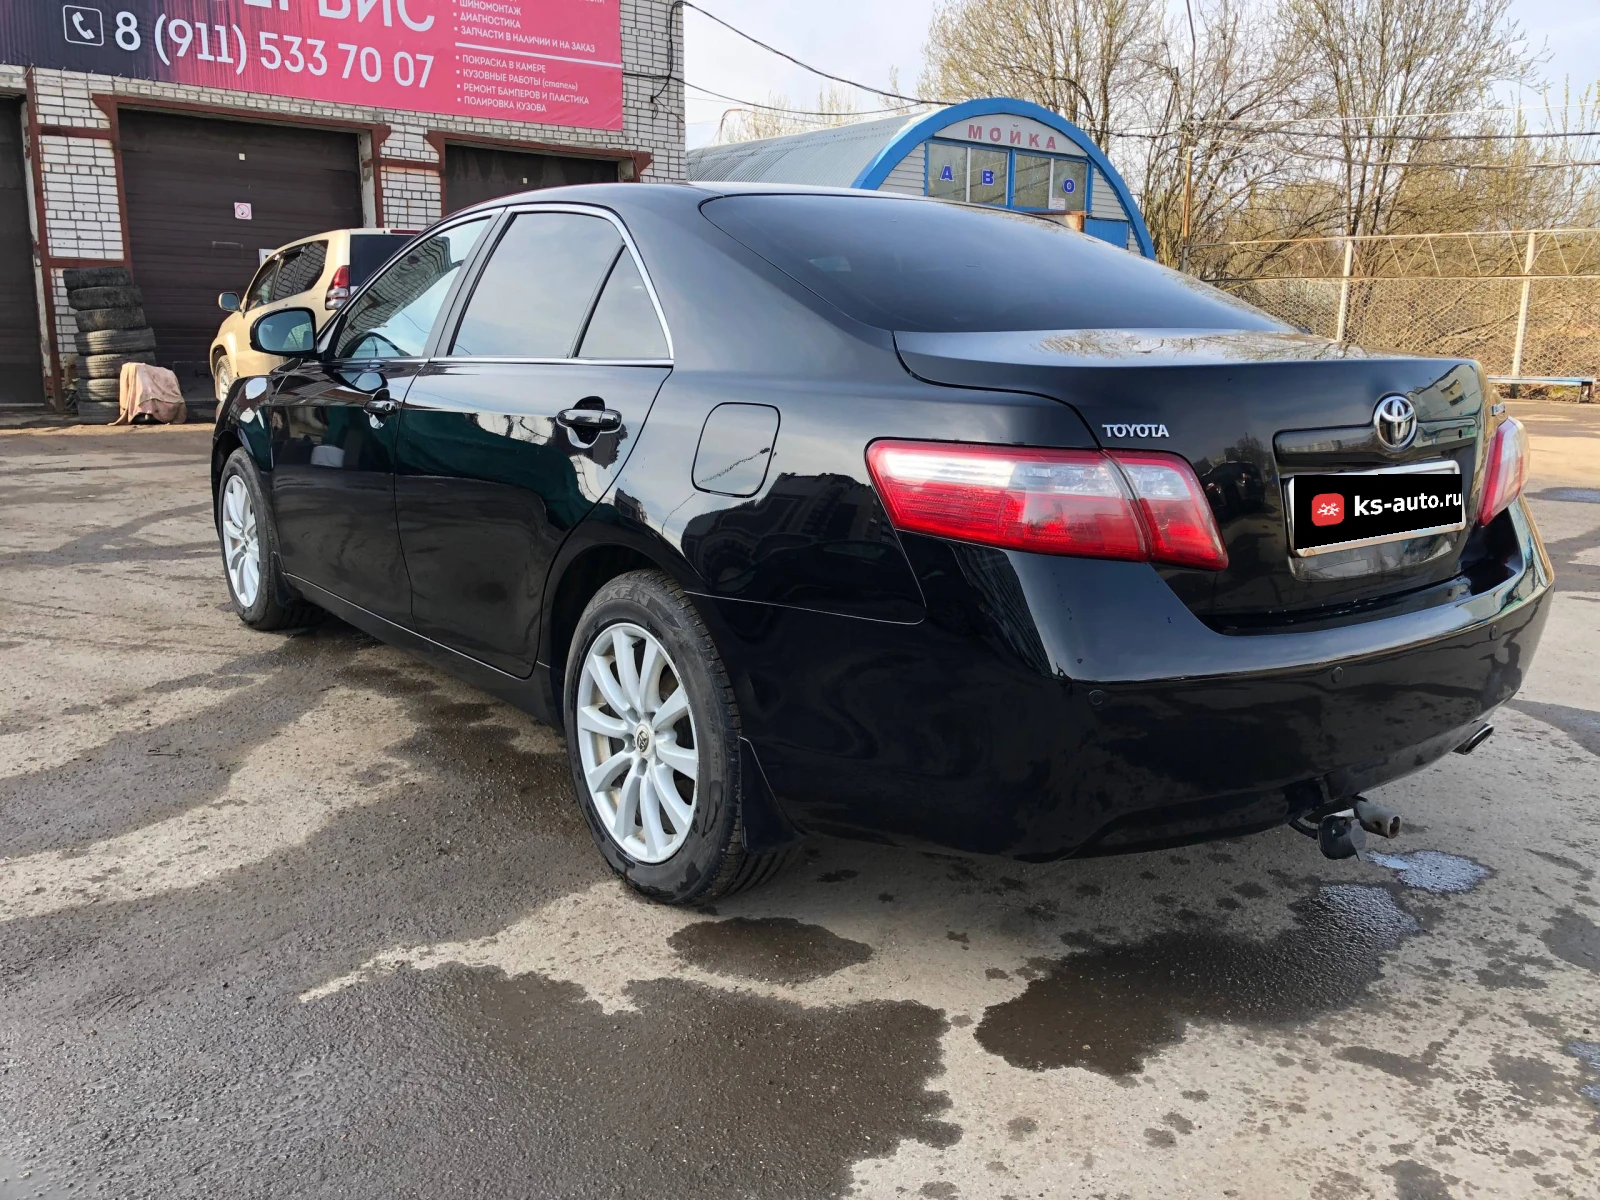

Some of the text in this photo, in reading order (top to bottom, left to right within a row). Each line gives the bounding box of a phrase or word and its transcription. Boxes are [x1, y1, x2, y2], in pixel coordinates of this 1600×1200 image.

[460, 0, 521, 15] ШИНОМОНТАЖ
[460, 12, 521, 28] ДИАГНОСТИКА
[115, 11, 141, 51] 8
[154, 13, 247, 75] (911)
[260, 32, 328, 76] 533
[338, 43, 382, 83] 70
[393, 51, 434, 88] 07
[461, 25, 595, 53] ЗАПЧАСТИ В НАЛИЧИИ И НА ЗАКАЗ
[462, 54, 546, 73] ПОКРАСКА В КАМЕРЕ
[463, 68, 578, 92] КУЗОВНЫЕ РАБОТЫ (стапель)
[463, 82, 589, 105] РЕМОНТ БАМПЕРОВ И ПЛАСТИКА
[464, 96, 547, 112] ПОЛИРОВКА КУЗОВА
[968, 124, 1056, 150] МОЙКА
[1102, 423, 1169, 438] TOYOTA
